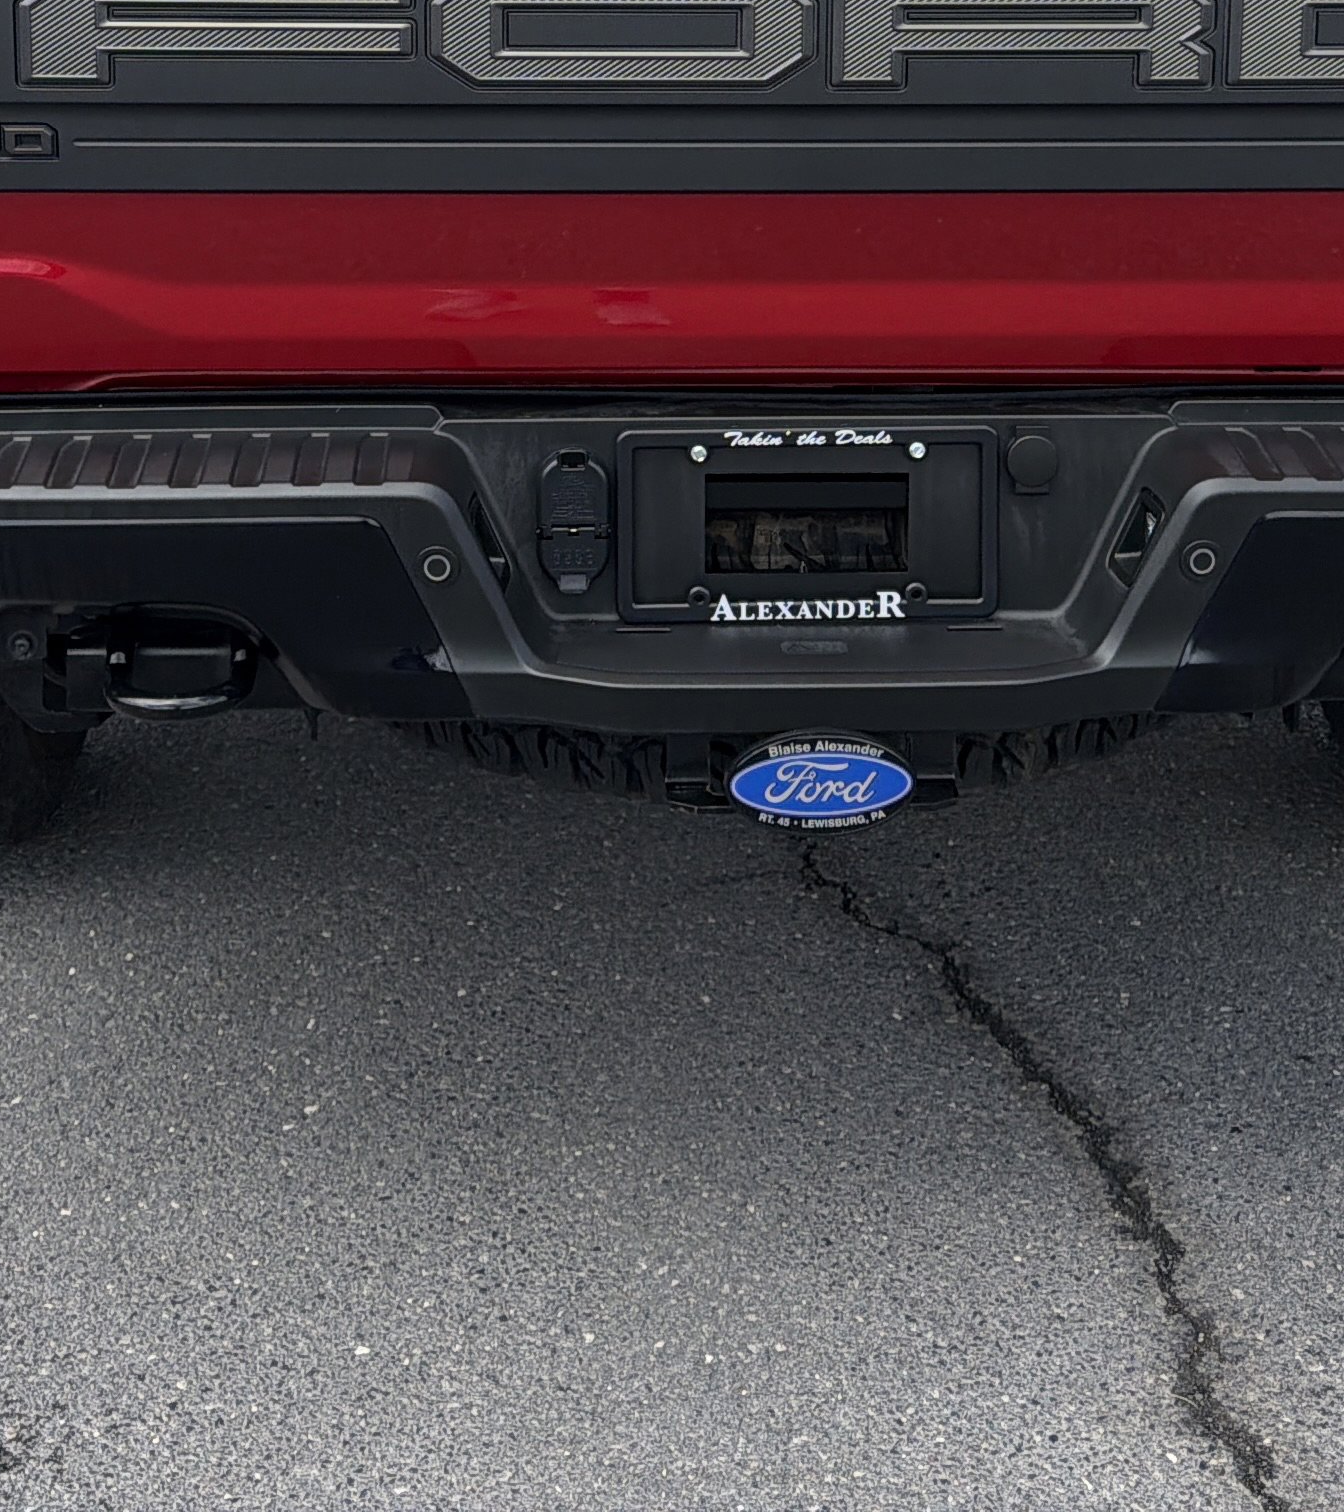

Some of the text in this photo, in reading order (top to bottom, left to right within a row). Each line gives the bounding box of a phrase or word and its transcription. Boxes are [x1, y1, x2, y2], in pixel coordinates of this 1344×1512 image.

[724, 429, 893, 446] Takin' the Deals
[768, 740, 884, 758] Blaise Alexander
[765, 760, 877, 804] Ford
[759, 809, 886, 829] RT. 45 LEWISBURG, PA
